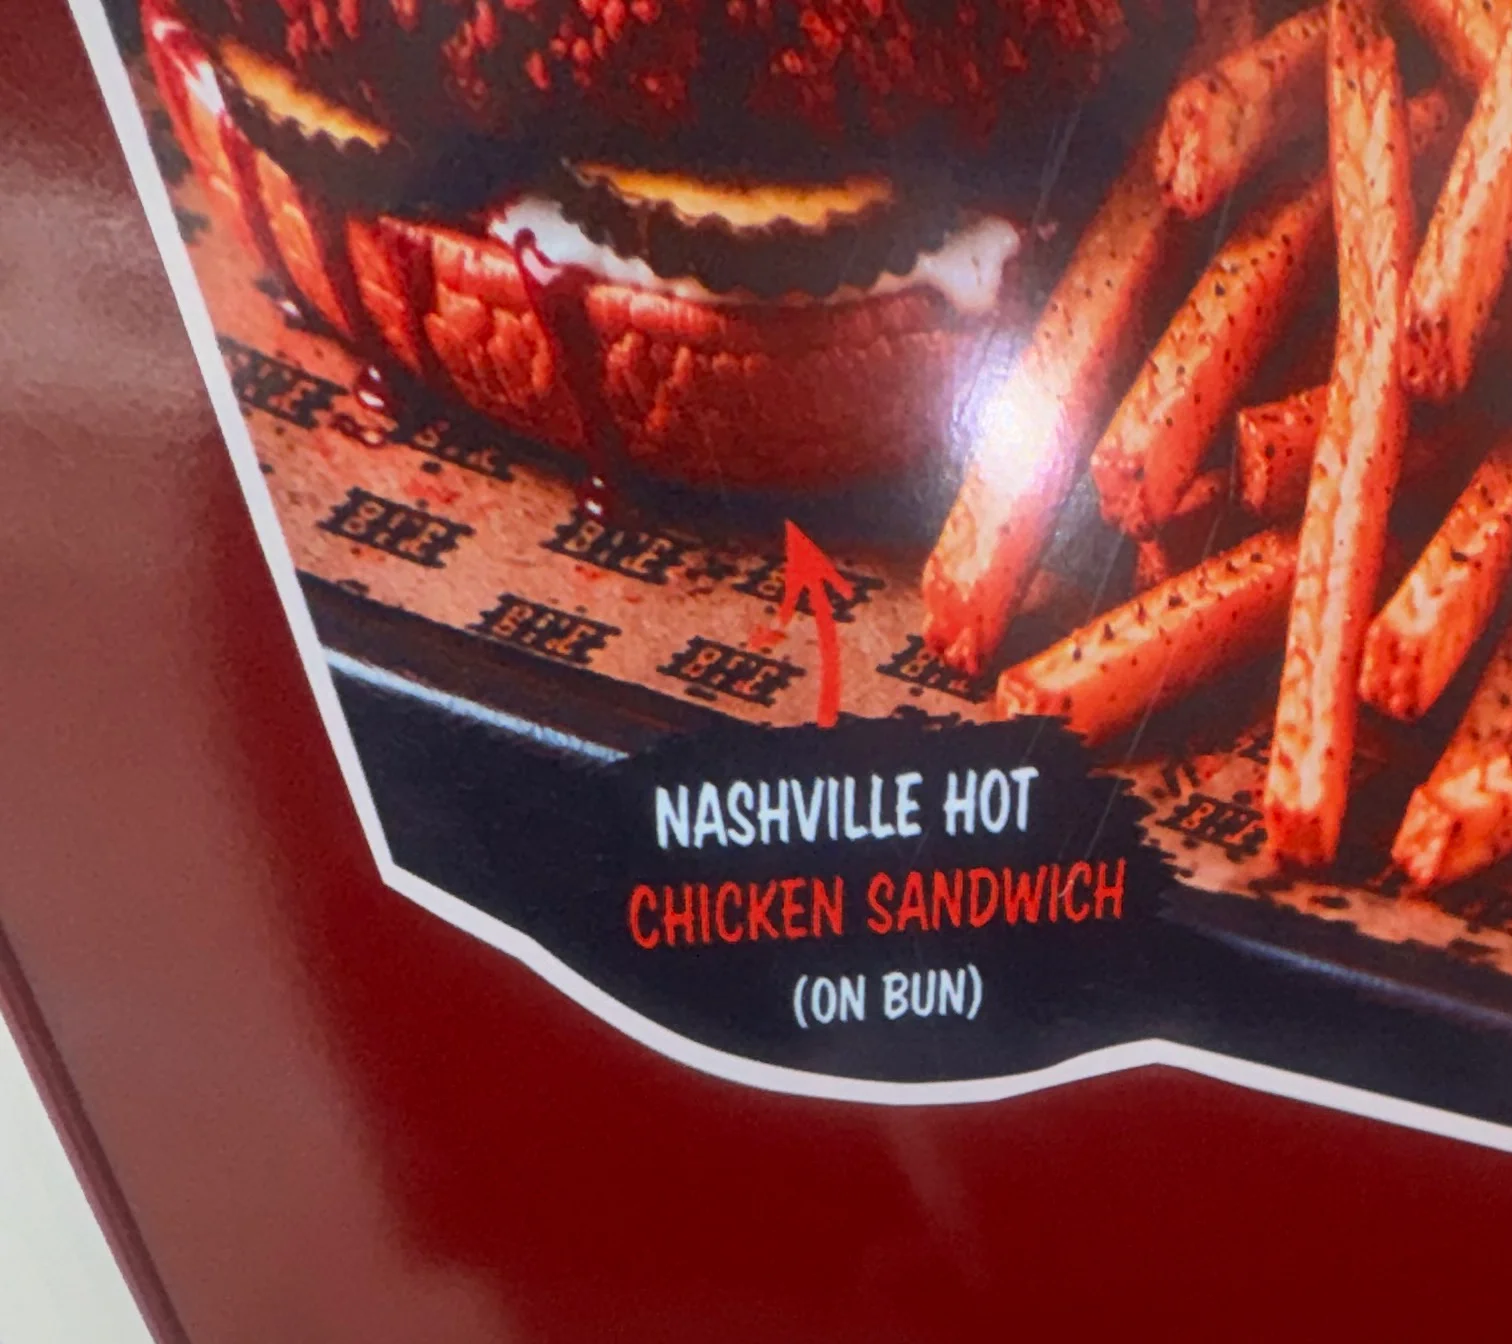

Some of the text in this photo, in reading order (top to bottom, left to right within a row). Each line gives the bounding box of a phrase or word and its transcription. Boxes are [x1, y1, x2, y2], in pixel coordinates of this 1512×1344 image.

[655, 766, 1039, 849] NASHVILLE HOT
[628, 858, 1127, 949] CHICKEN SANDWICH
[793, 963, 983, 1028] (ON BUN)
